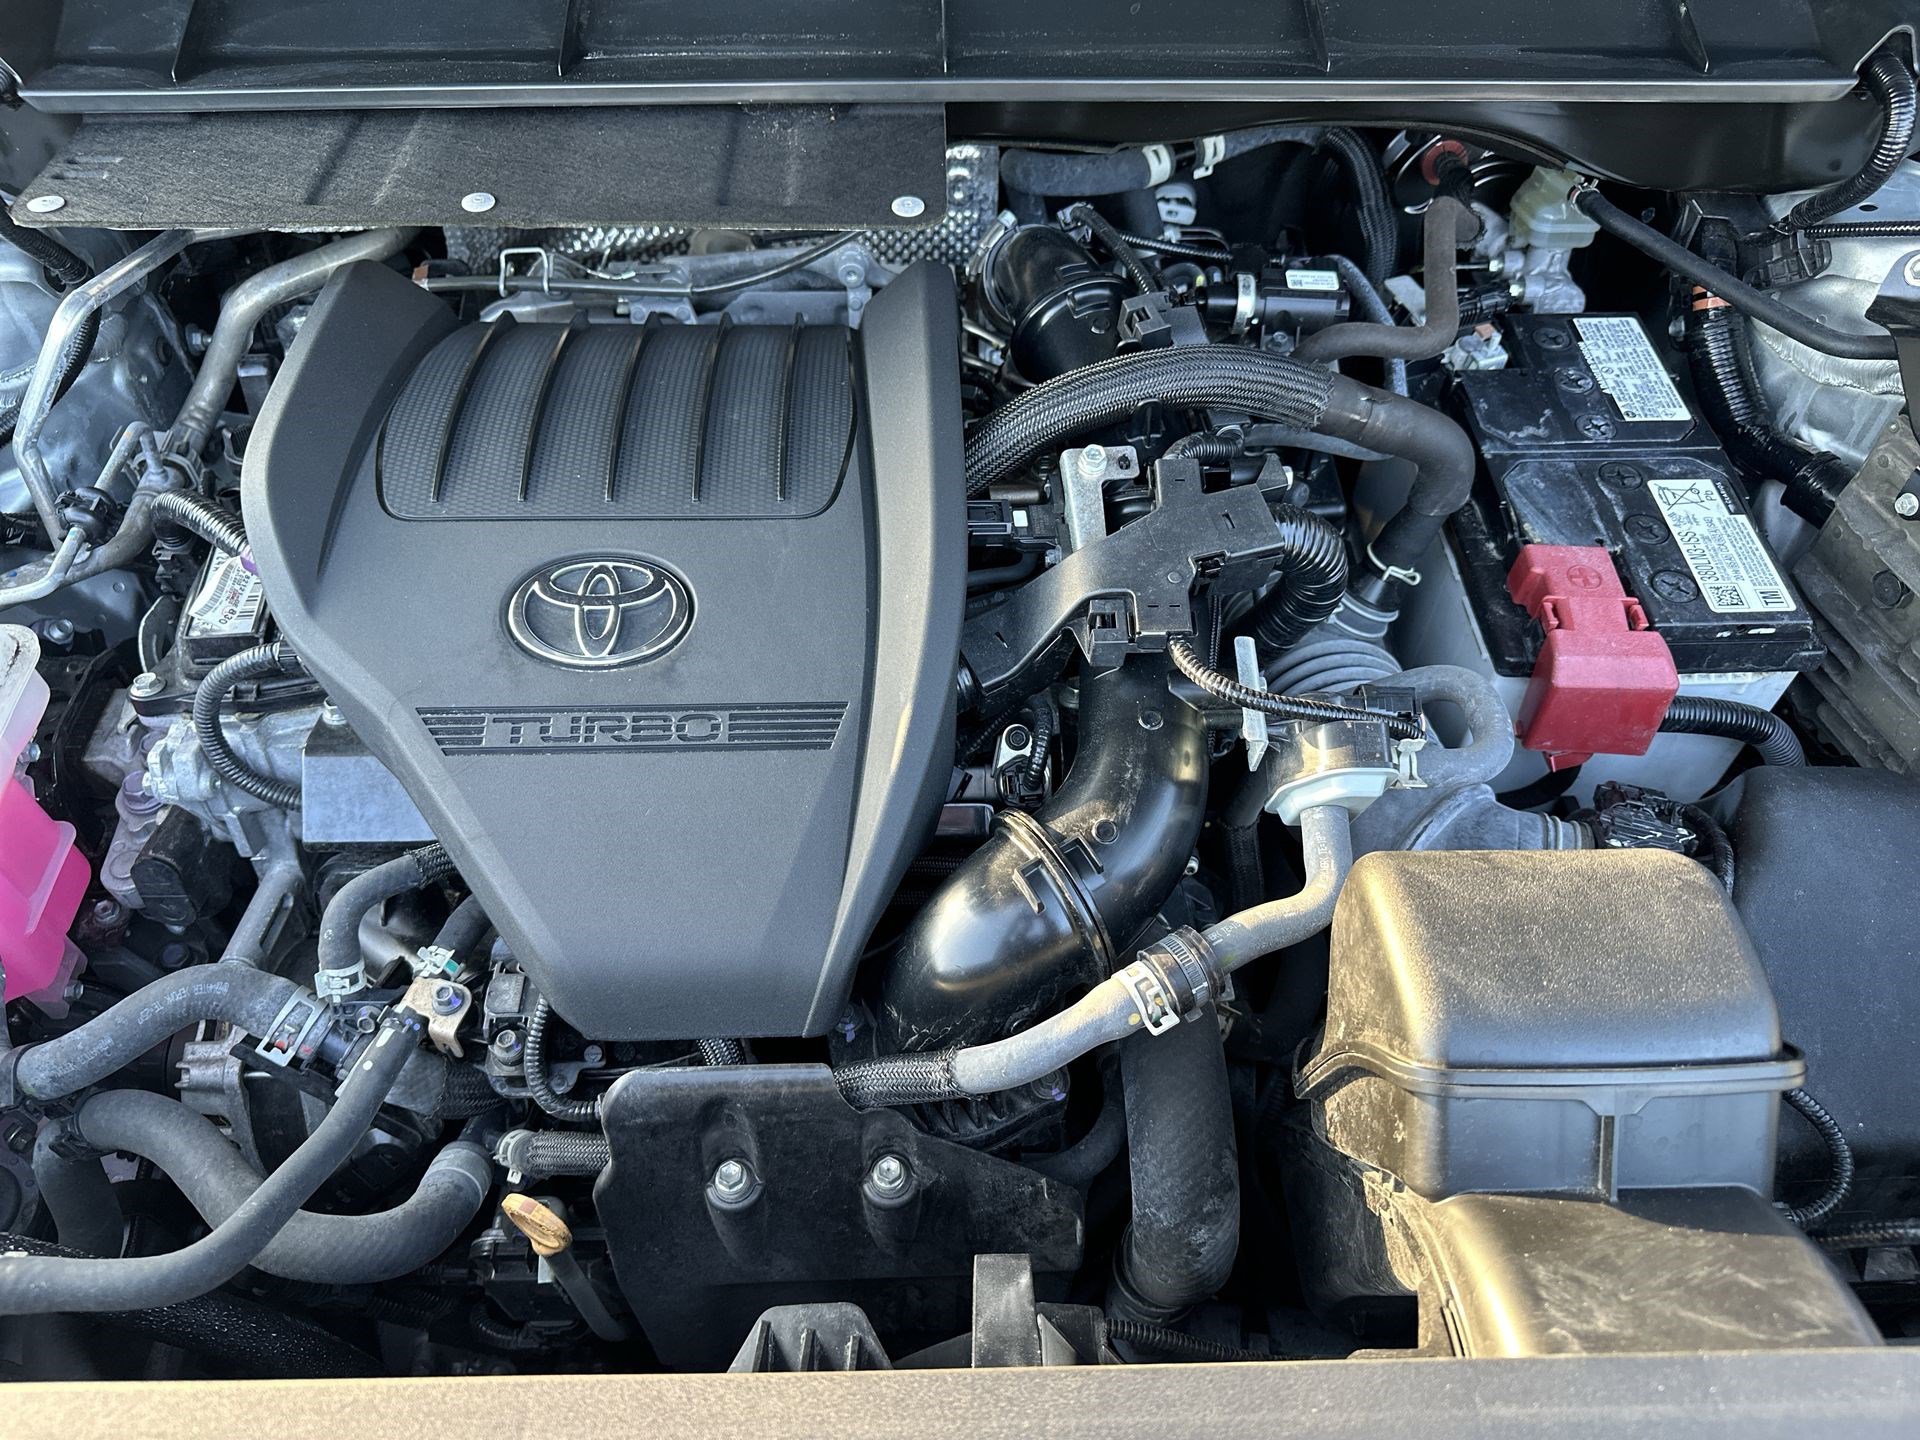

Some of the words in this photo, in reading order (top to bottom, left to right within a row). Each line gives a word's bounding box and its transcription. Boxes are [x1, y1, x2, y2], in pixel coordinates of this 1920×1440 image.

[1704, 490, 1717, 502] Pb
[1759, 590, 1784, 606] TM
[493, 713, 723, 745] TURBO
